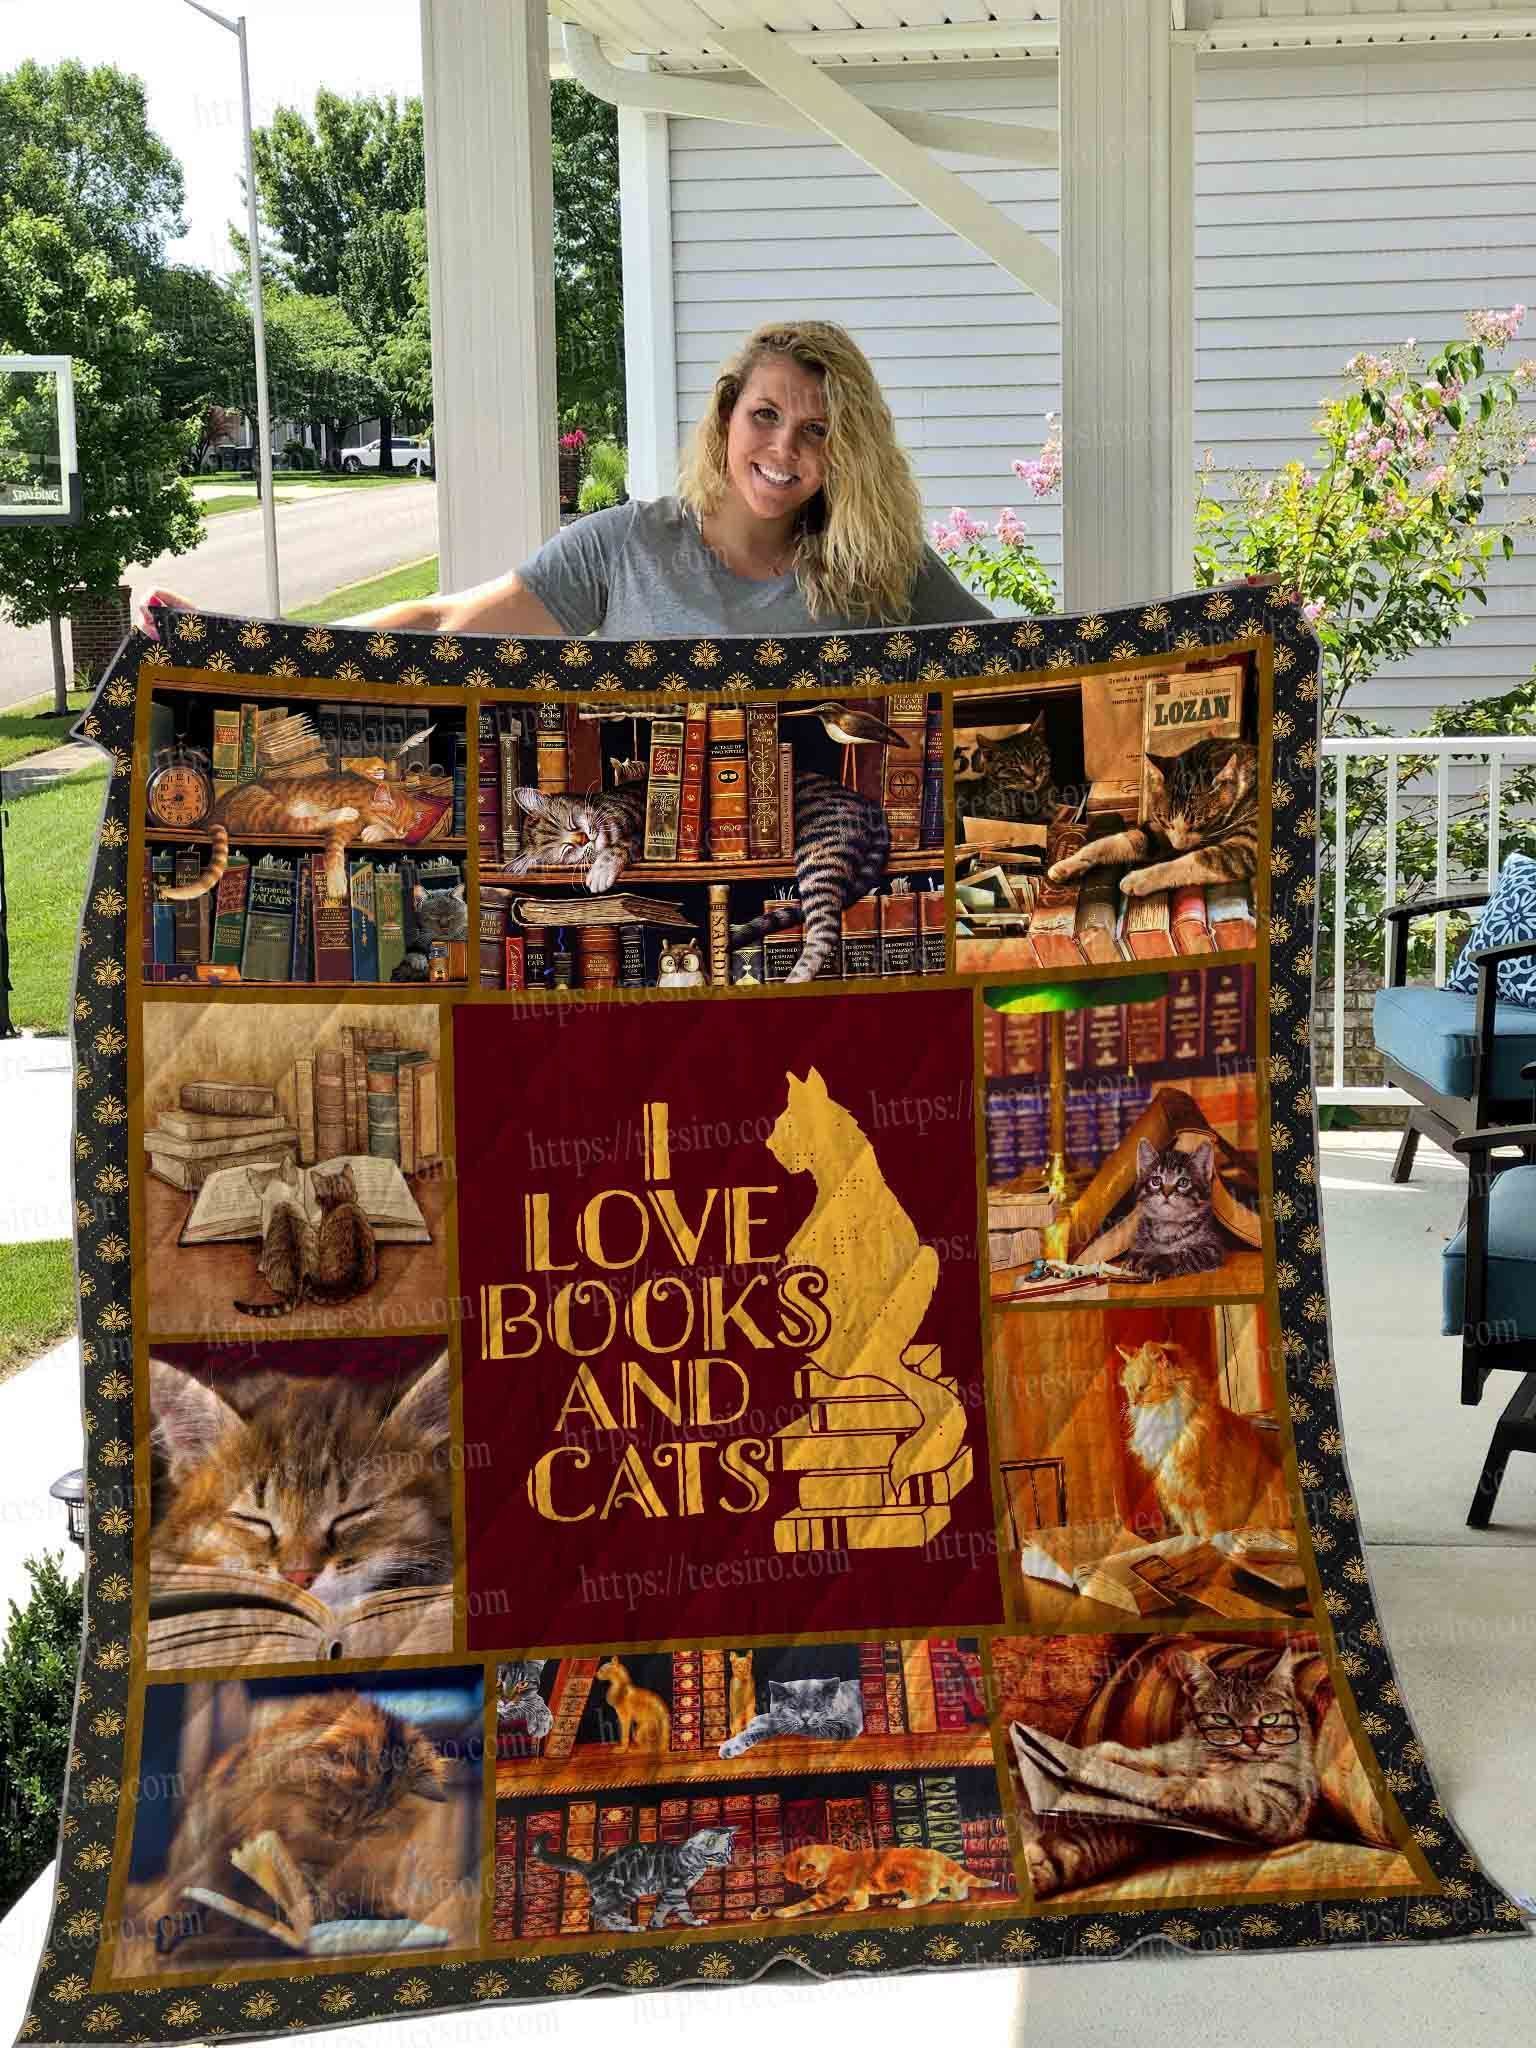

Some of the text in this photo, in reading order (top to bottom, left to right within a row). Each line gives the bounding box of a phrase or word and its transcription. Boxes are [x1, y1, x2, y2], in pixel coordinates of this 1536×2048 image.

[13, 489, 60, 501] SPALDING
[1153, 695, 1231, 726] LOZAN
[643, 1102, 670, 1181] I
[524, 1186, 781, 1273] LOVE
[480, 1265, 829, 1361] BOOKS
[553, 1358, 751, 1432] AND
[527, 1438, 771, 1523] CATS
